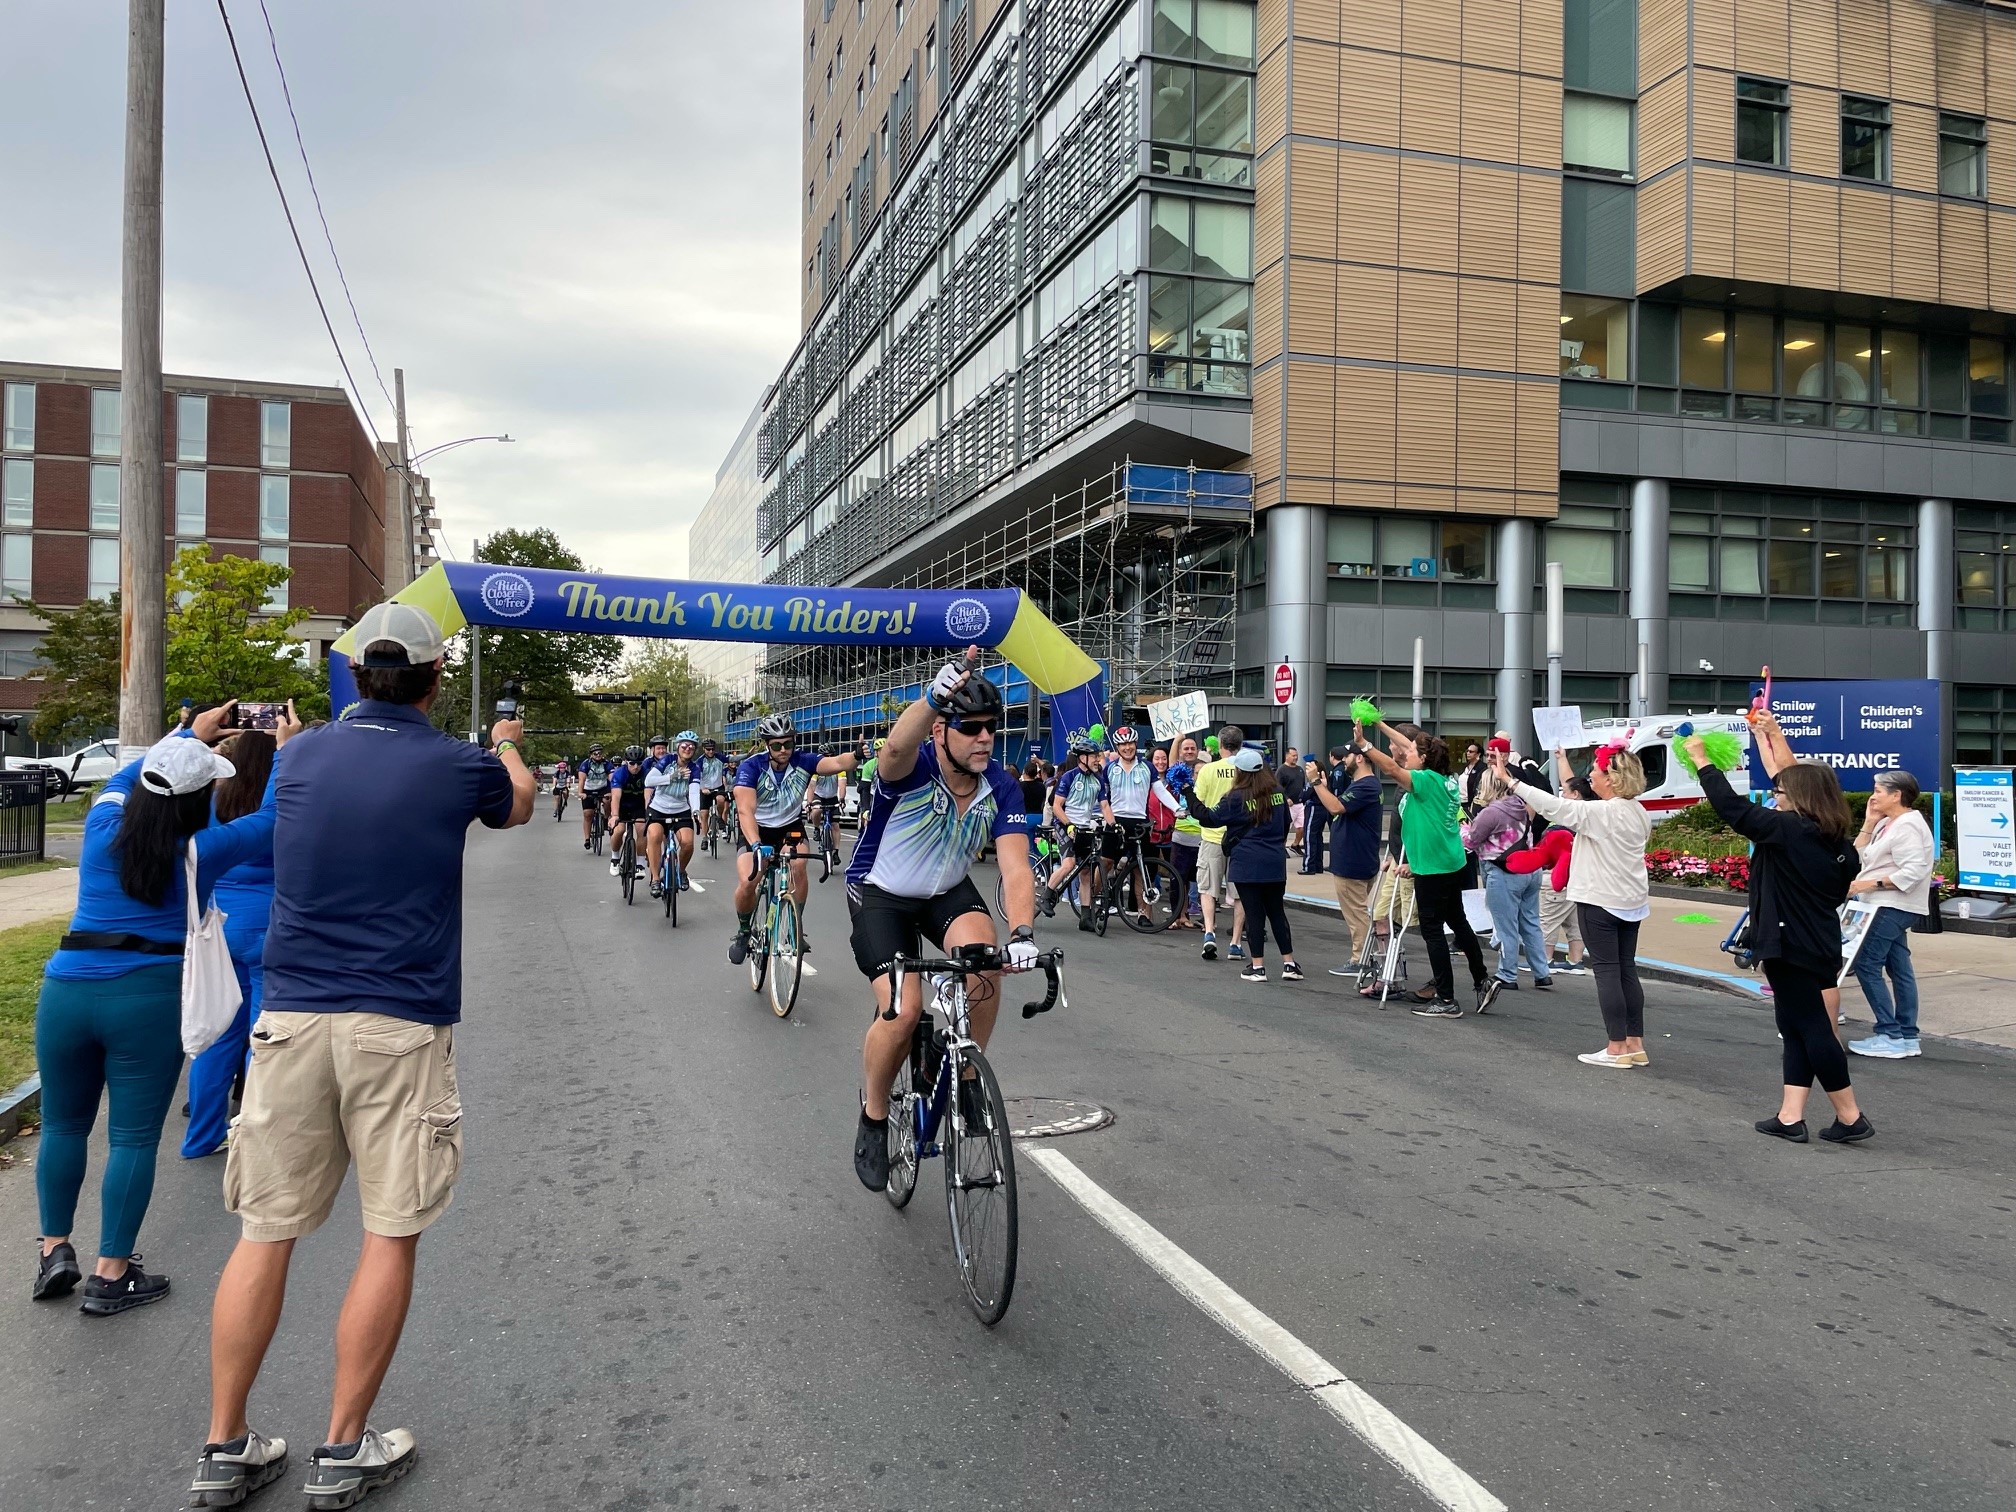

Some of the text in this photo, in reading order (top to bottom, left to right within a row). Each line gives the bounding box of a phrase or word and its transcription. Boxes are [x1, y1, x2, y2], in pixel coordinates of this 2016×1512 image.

[495, 579, 524, 591] Ride
[487, 588, 517, 599] Closer
[495, 597, 526, 608] to Free
[557, 581, 917, 635] Thank You Riders!
[956, 606, 981, 617] Ride
[950, 615, 976, 626] Closer
[964, 623, 983, 632] Free
[1276, 671, 1291, 680] DO NOT
[1277, 689, 1289, 697] ENTER
[1152, 695, 1196, 717] YOU
[1771, 700, 1816, 711] Smilow
[1860, 705, 1923, 717] Children's
[1772, 713, 1814, 724] Cancer
[1860, 718, 1912, 732] Hospital
[1778, 725, 1822, 739] ospital
[1992, 842, 2012, 850] VALET
[1982, 850, 2000, 858] DROP
